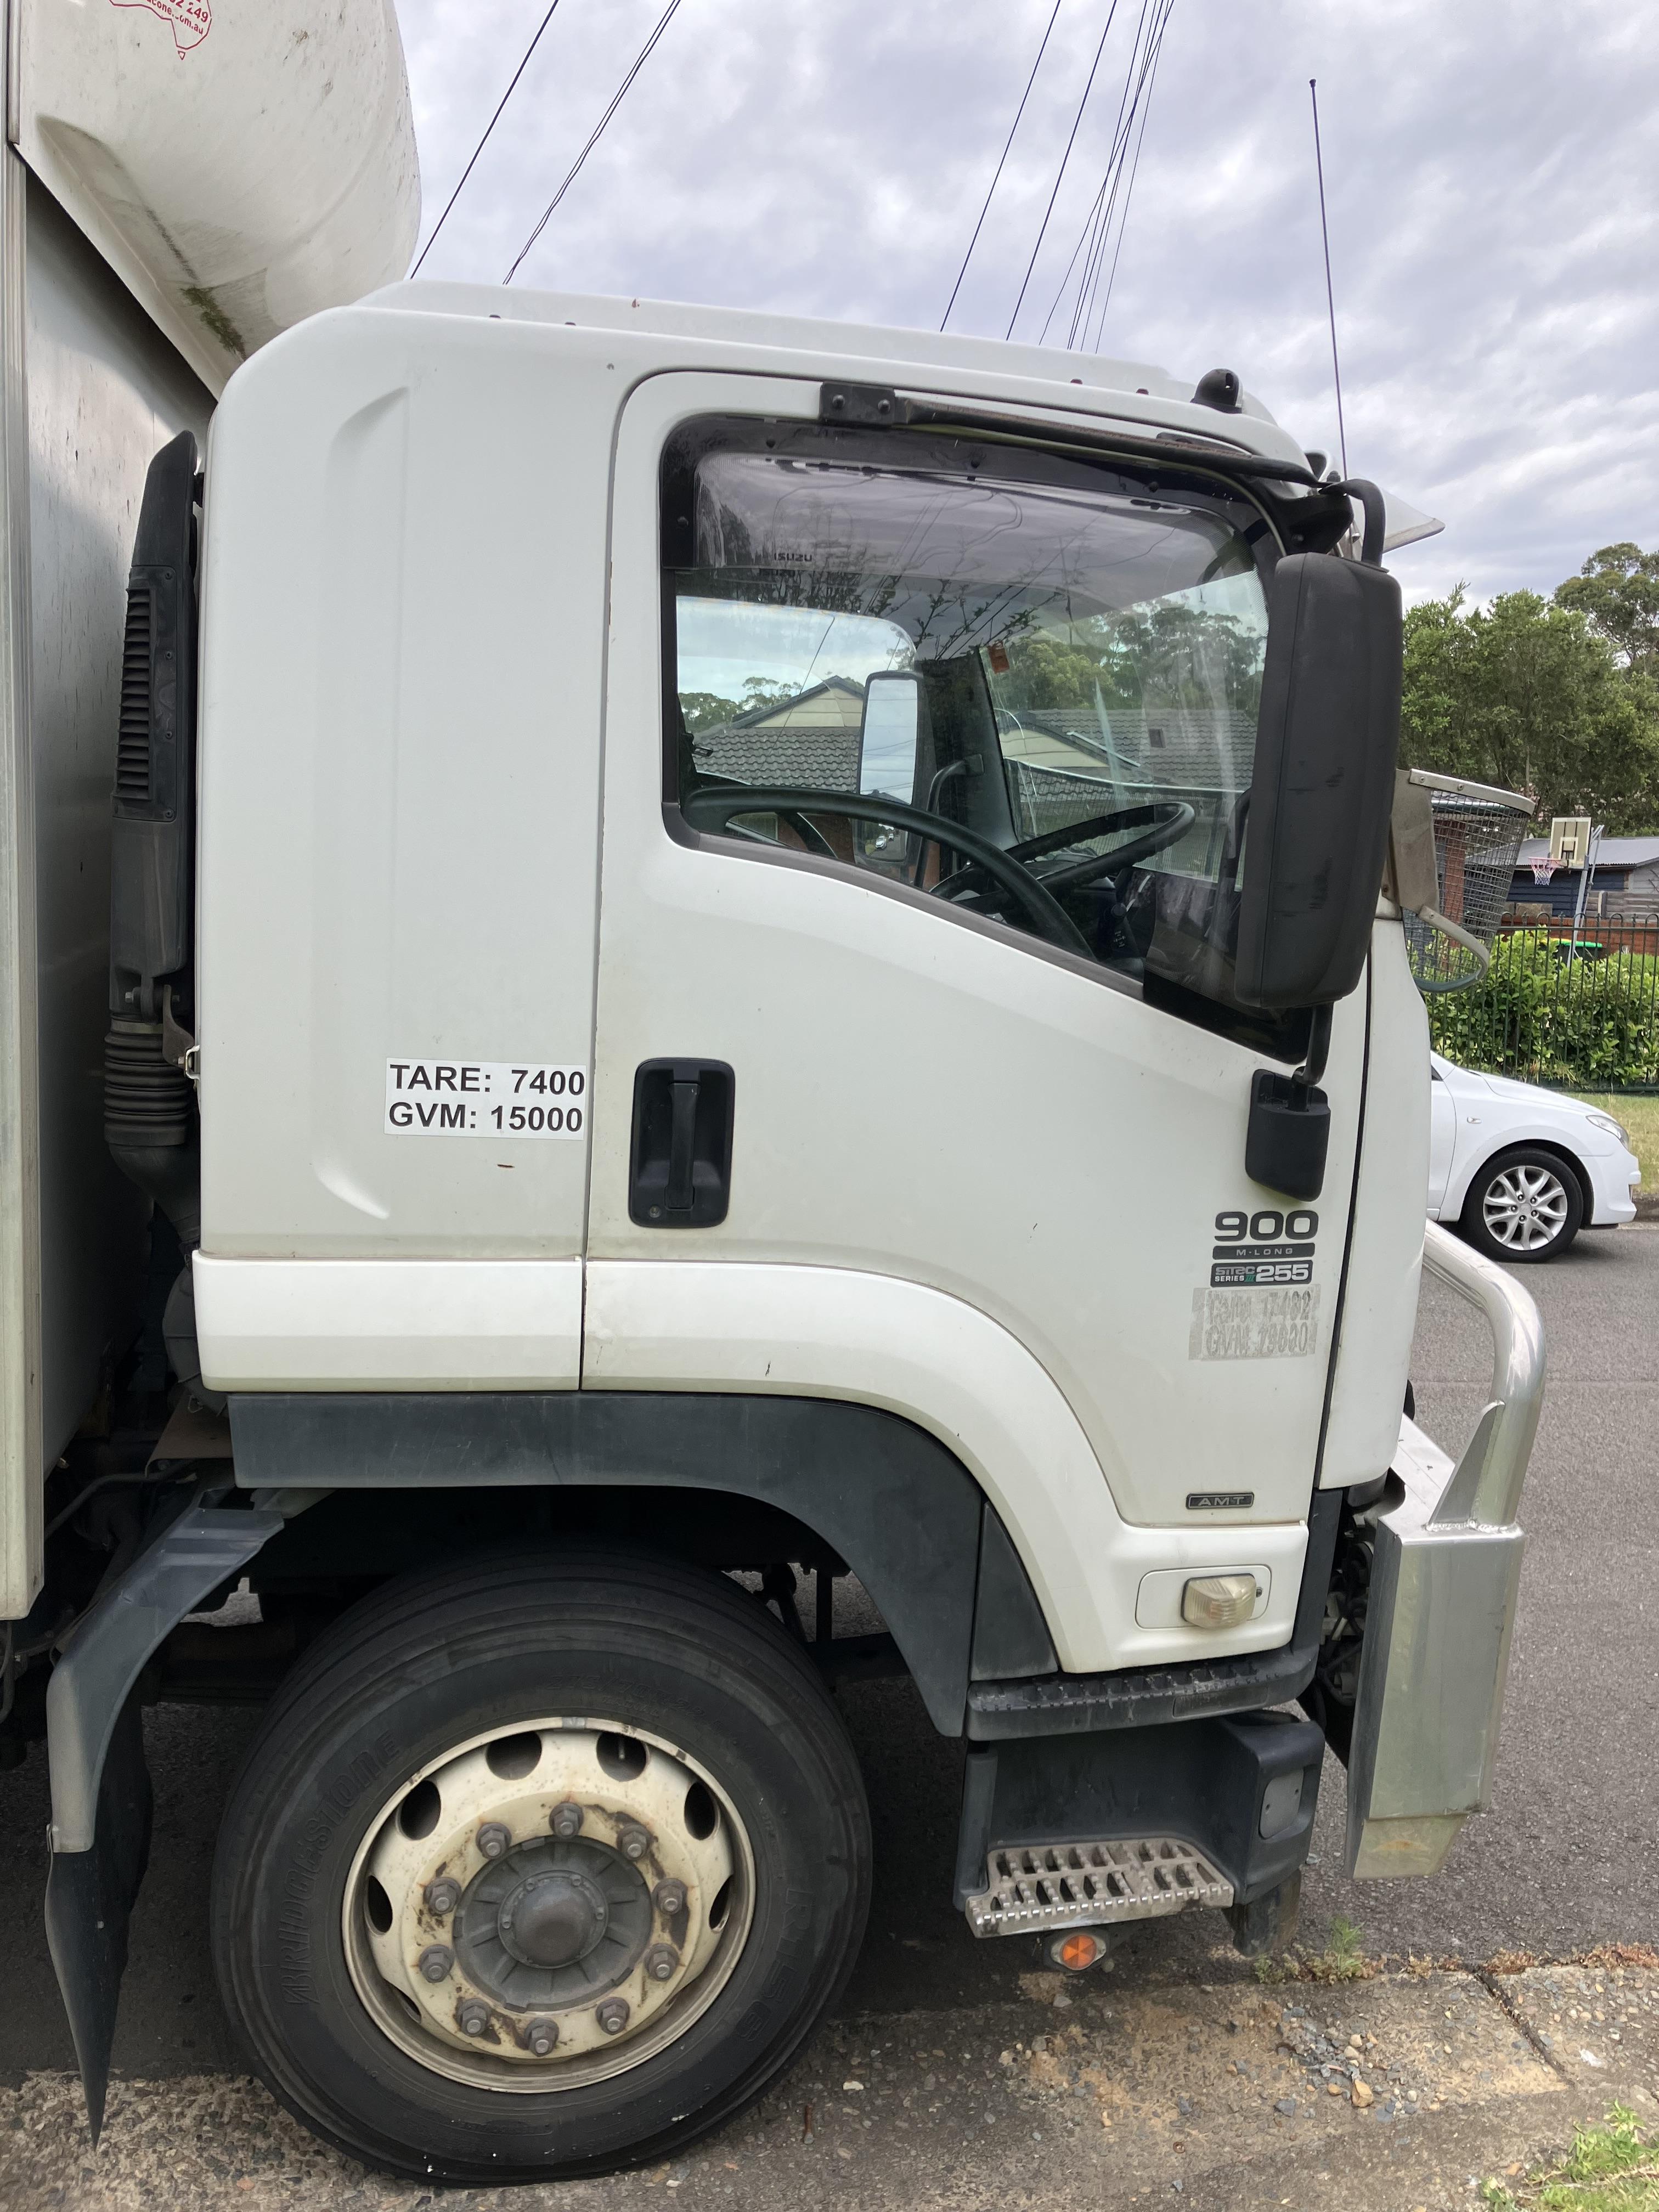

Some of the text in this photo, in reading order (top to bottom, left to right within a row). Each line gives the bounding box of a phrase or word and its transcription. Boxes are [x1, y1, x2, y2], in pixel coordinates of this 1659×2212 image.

[186, 2, 208, 22] 249
[774, 553, 812, 562] ISUZU
[390, 1064, 585, 1096] TARE: 7400
[389, 1102, 583, 1132] GVM: 15000
[1214, 1210, 1319, 1242] 900
[1236, 1248, 1293, 1256] M-LONG
[1256, 1264, 1309, 1282] 255
[1198, 1497, 1244, 1506] AMT
[279, 1729, 399, 2004] BRIDGESTONE
